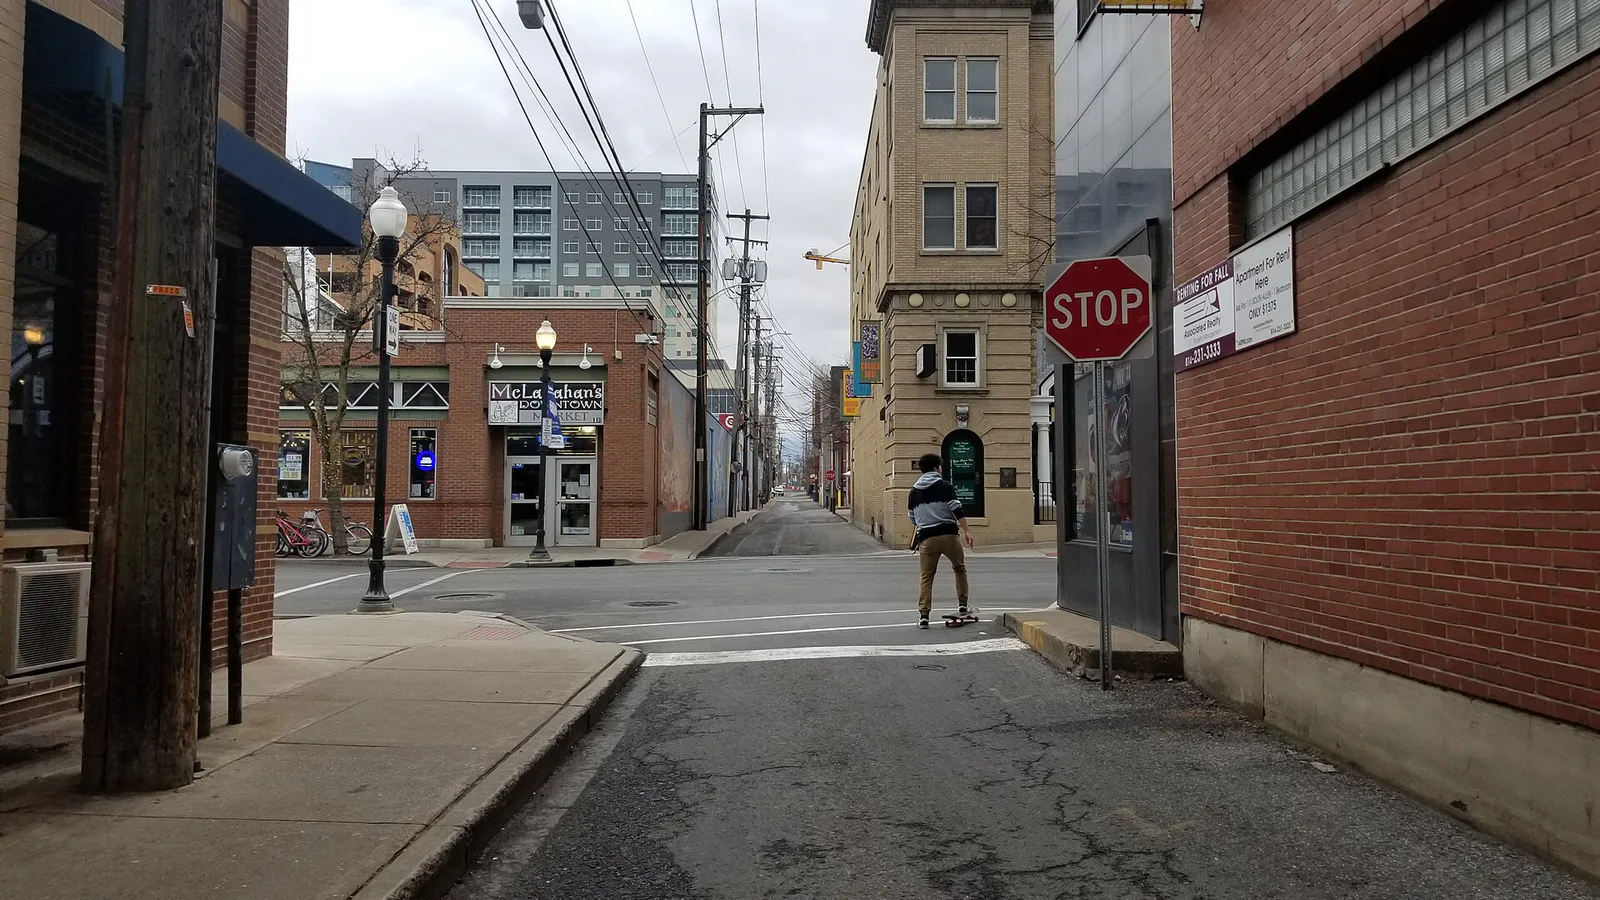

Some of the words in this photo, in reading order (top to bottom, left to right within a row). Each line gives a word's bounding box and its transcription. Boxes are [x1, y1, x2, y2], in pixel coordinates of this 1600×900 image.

[1235, 261, 1265, 286] Apartment
[1265, 257, 1275, 271] For
[1276, 247, 1290, 263] Rent
[1176, 280, 1200, 302] RENTING
[1201, 272, 1213, 290] FOR
[1214, 264, 1229, 282] FALL
[1254, 276, 1269, 291] Here
[1276, 282, 1291, 295] Bedroom
[389, 311, 398, 324] ONE
[1052, 288, 1143, 329] STOP
[1248, 307, 1262, 320] ONLY
[1262, 299, 1277, 315] $1375
[1184, 322, 1206, 339] Associated
[1206, 316, 1221, 330] Realty
[1185, 341, 1221, 366] 814-231-3333
[491, 383, 603, 399] McLaahan's
[519, 400, 602, 409] DONTOWN
[533, 412, 588, 421] MRKET
